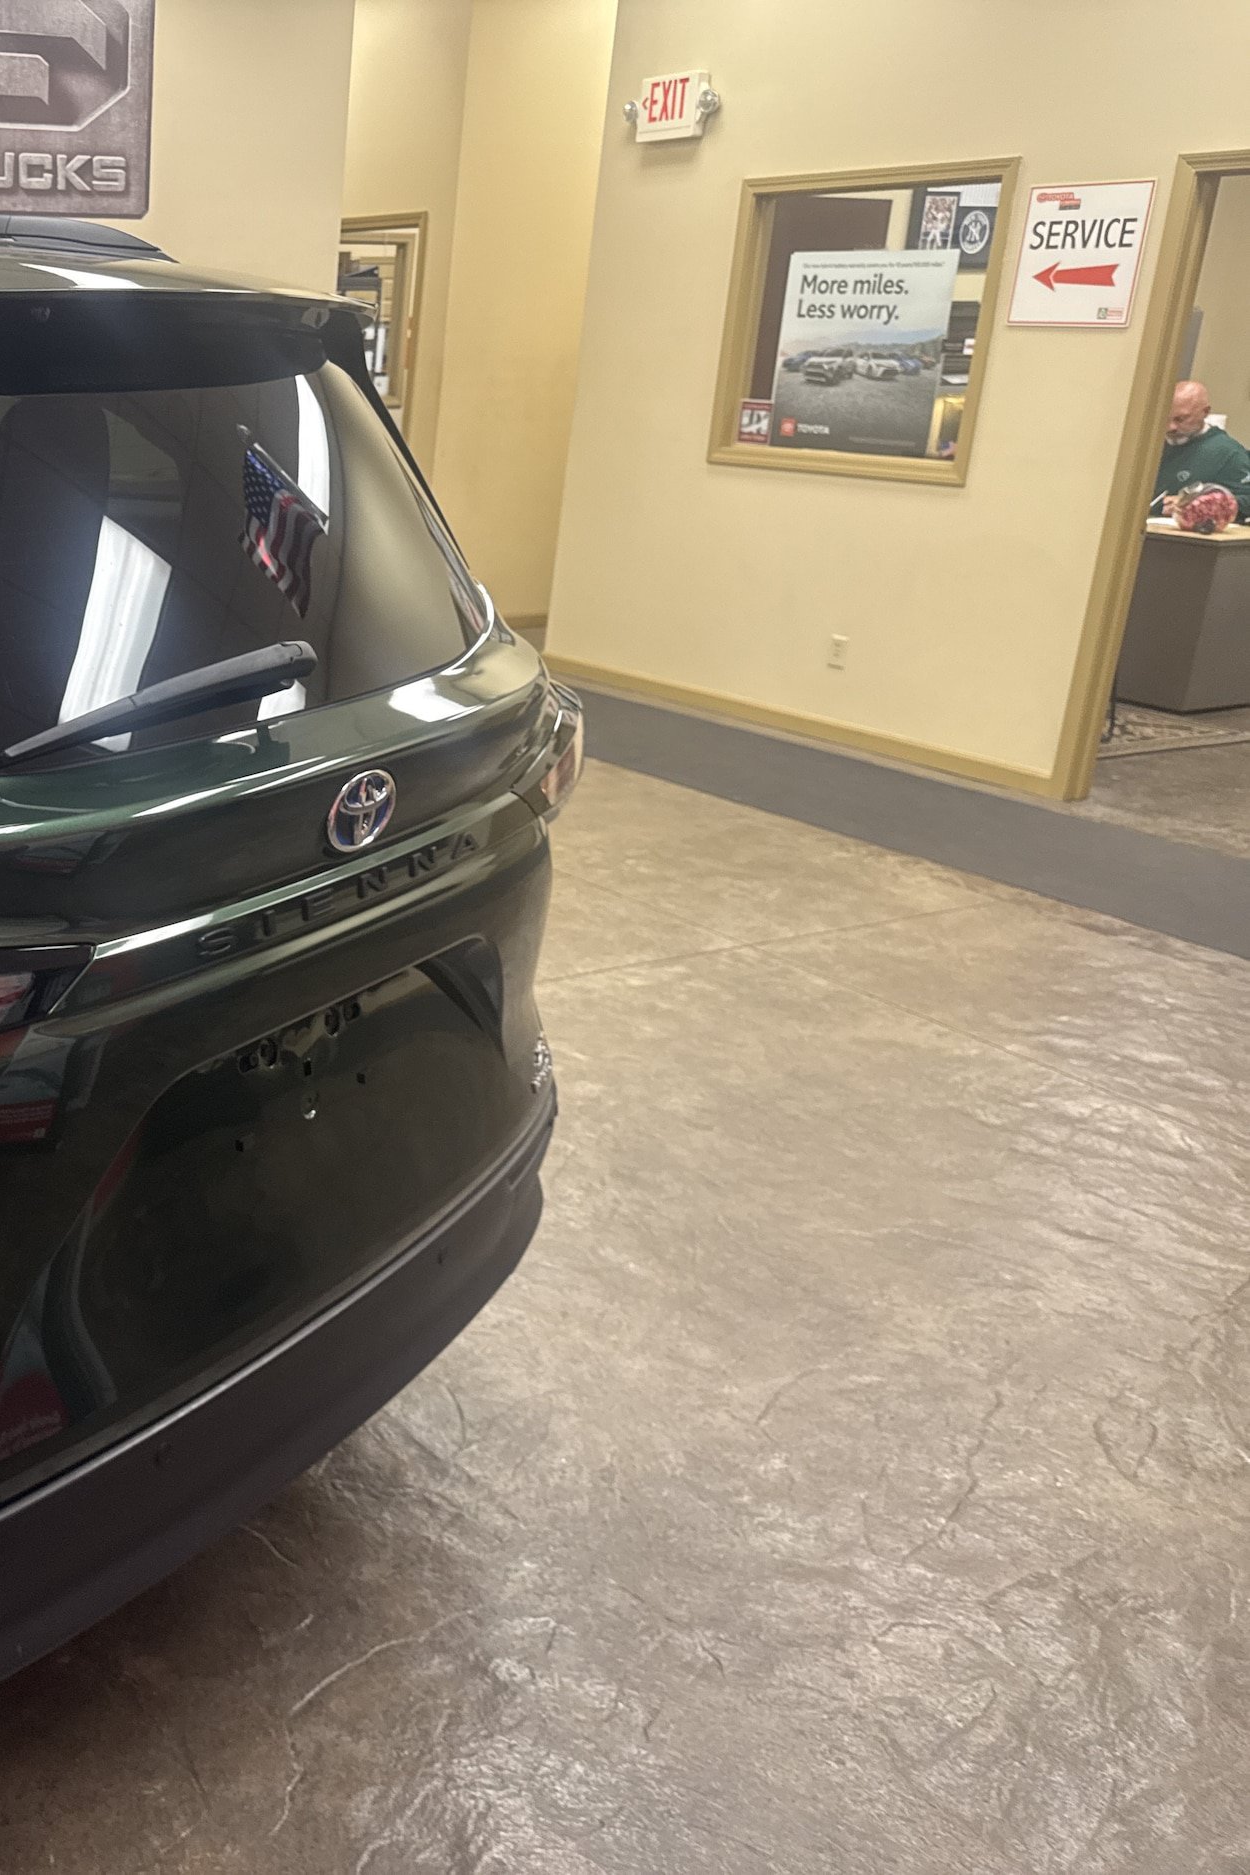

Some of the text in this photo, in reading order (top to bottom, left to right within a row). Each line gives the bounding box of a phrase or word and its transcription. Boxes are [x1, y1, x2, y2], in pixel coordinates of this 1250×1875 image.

[648, 77, 690, 123] EXIT
[1029, 217, 1138, 250] SERVICE
[800, 273, 909, 295] More miles.
[797, 299, 899, 326] Less worry.
[797, 423, 830, 435] TOYOTA
[196, 831, 482, 957] SIENNA
